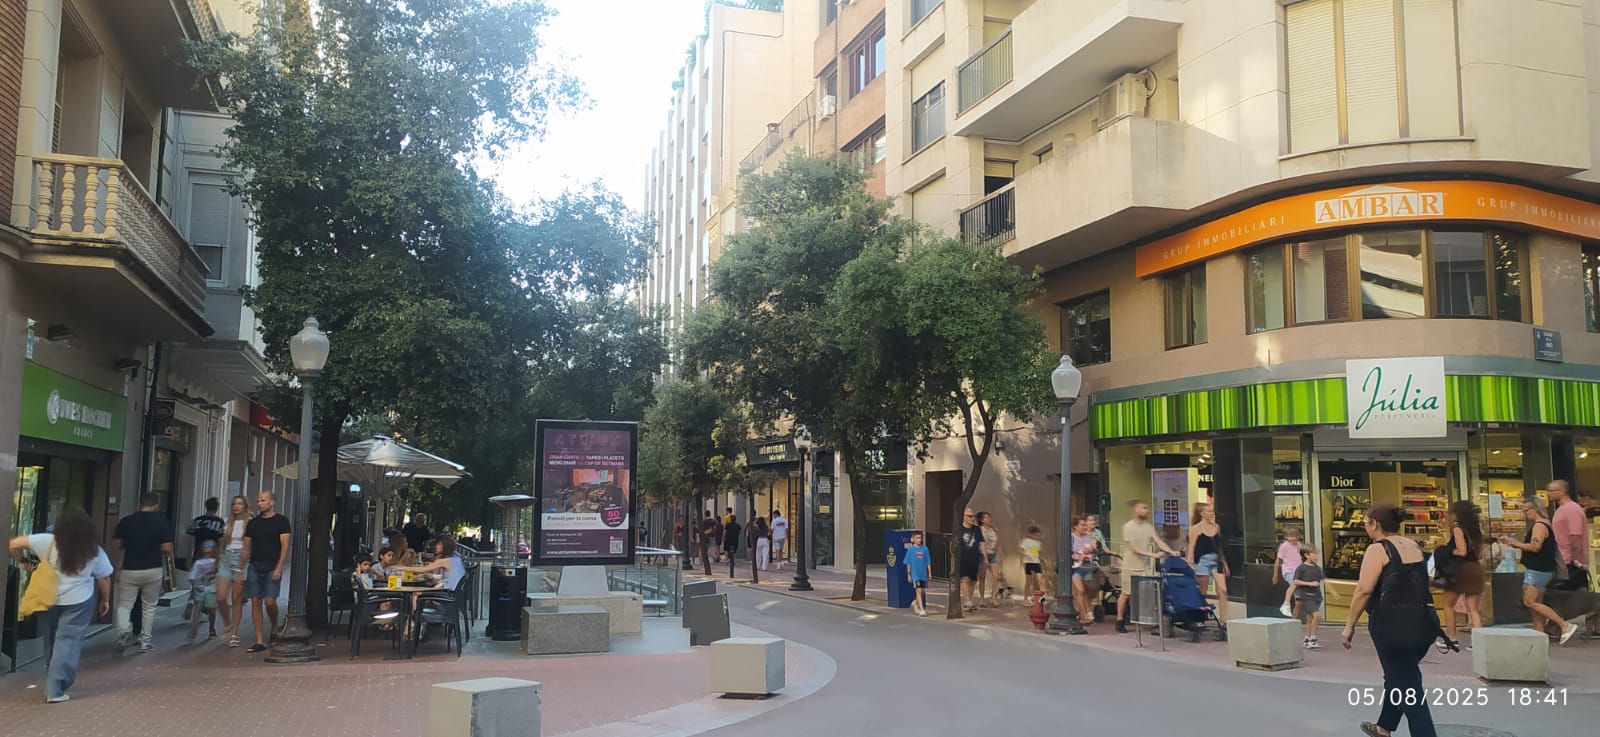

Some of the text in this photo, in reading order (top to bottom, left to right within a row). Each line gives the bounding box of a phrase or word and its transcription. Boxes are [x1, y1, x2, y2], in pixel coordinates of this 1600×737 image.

[1316, 194, 1441, 222] AMBAR
[1477, 196, 1516, 210] GRUP
[1163, 215, 1286, 260] GRUP IMMOBILIARI
[1355, 366, 1440, 430] Júlia
[1331, 475, 1355, 488] Dior
